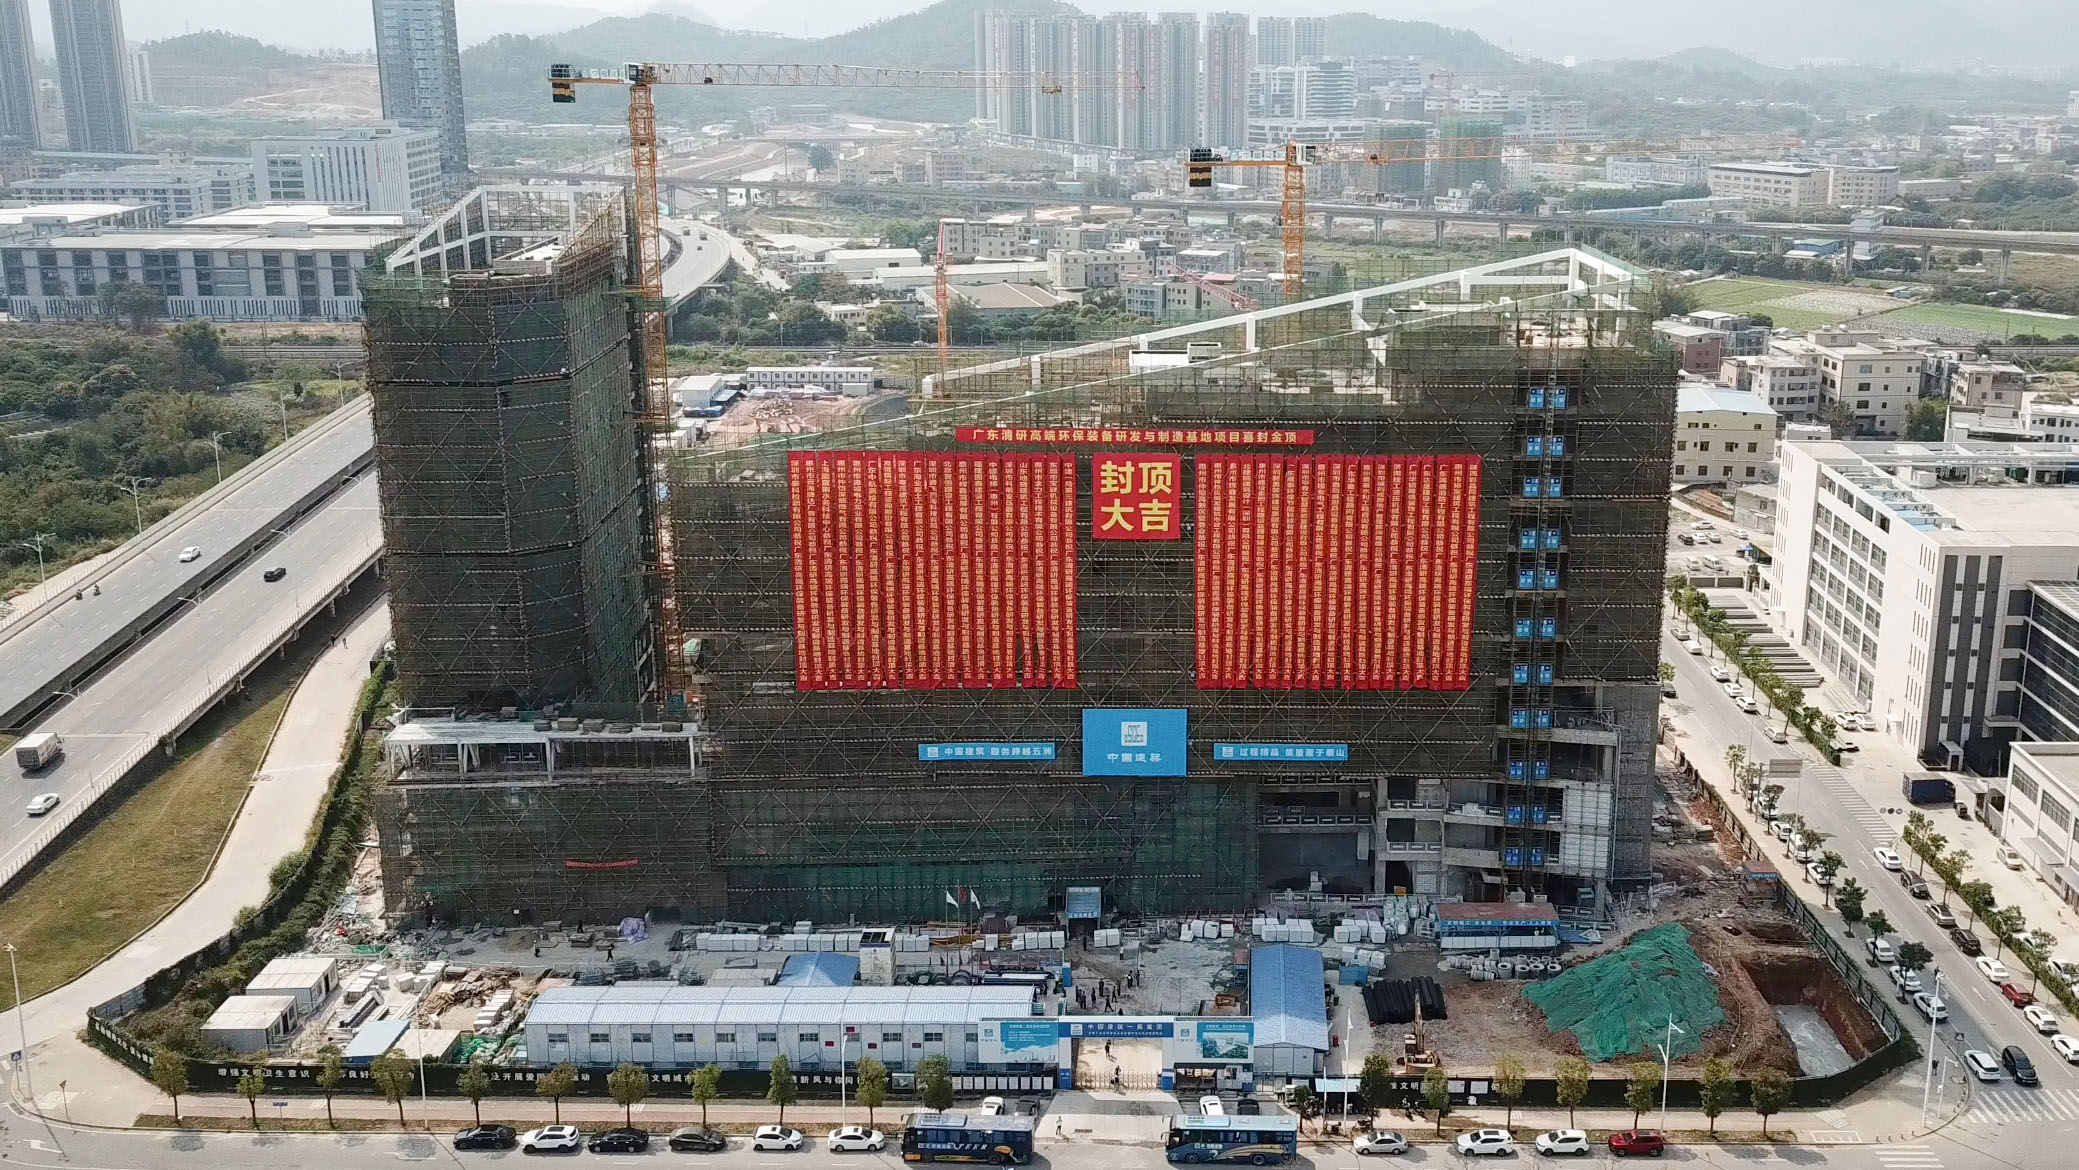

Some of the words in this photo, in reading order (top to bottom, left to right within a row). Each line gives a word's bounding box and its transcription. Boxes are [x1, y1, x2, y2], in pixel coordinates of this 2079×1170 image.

[973, 429, 1297, 443] 广东清研高端环保装备研发与制造基地项目喜封金顶
[1100, 460, 1173, 496] 封顶
[1100, 499, 1173, 533] 大吉
[944, 747, 984, 756] 中国建筑
[217, 1068, 310, 1078] 增强文明卫生意识
